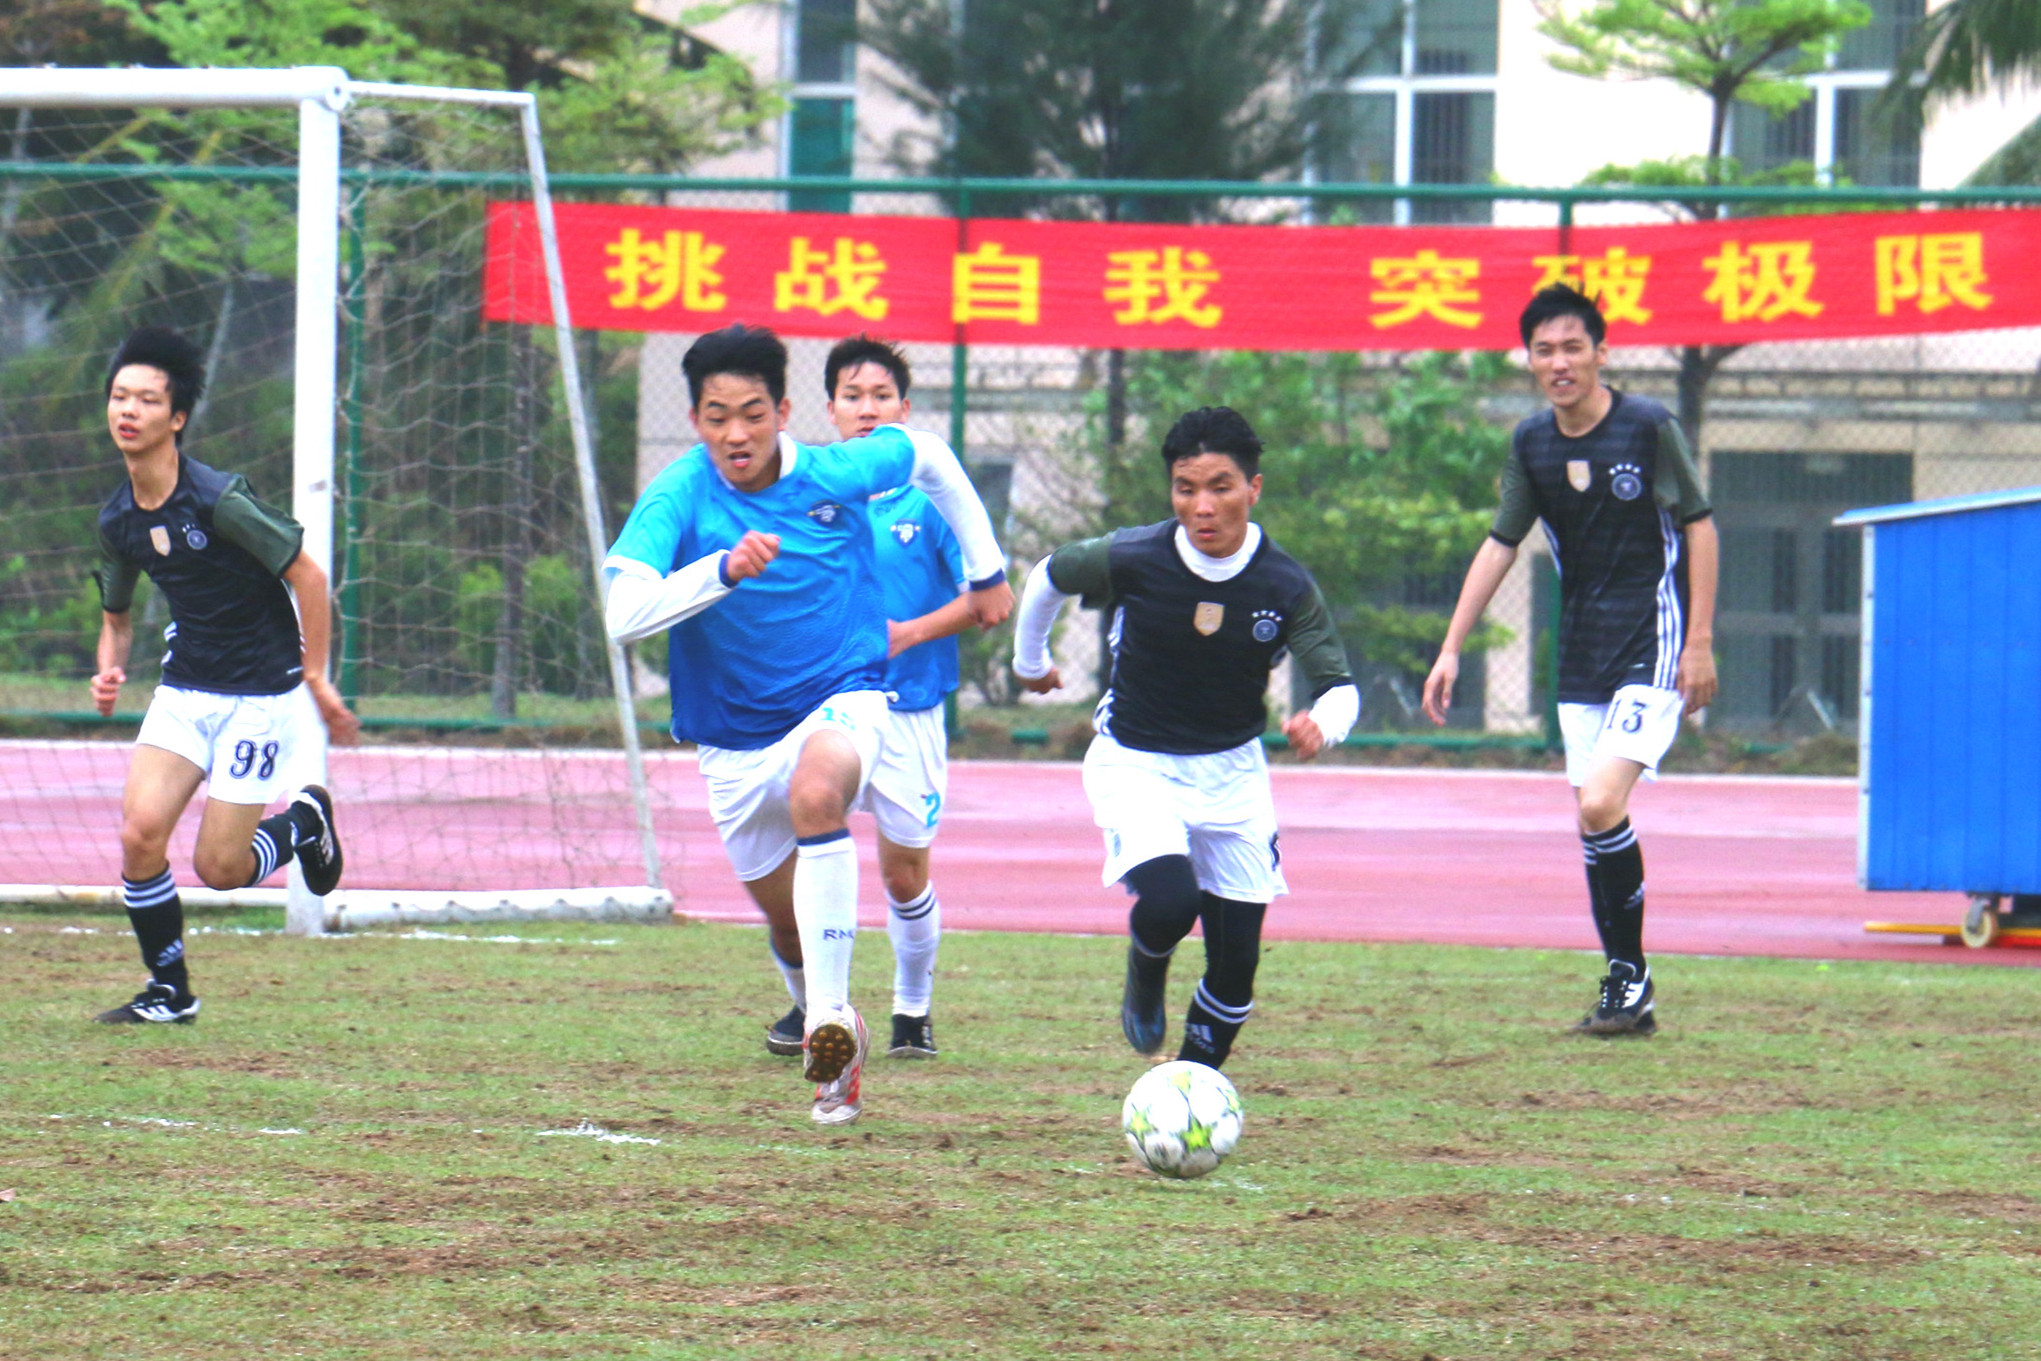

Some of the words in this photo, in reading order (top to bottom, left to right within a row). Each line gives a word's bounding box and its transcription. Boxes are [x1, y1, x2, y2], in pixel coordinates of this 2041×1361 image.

[604, 228, 1222, 327] 挑战自我
[1369, 232, 1993, 329] 突破极限
[1606, 698, 1647, 735] 13
[229, 738, 279, 781] 98
